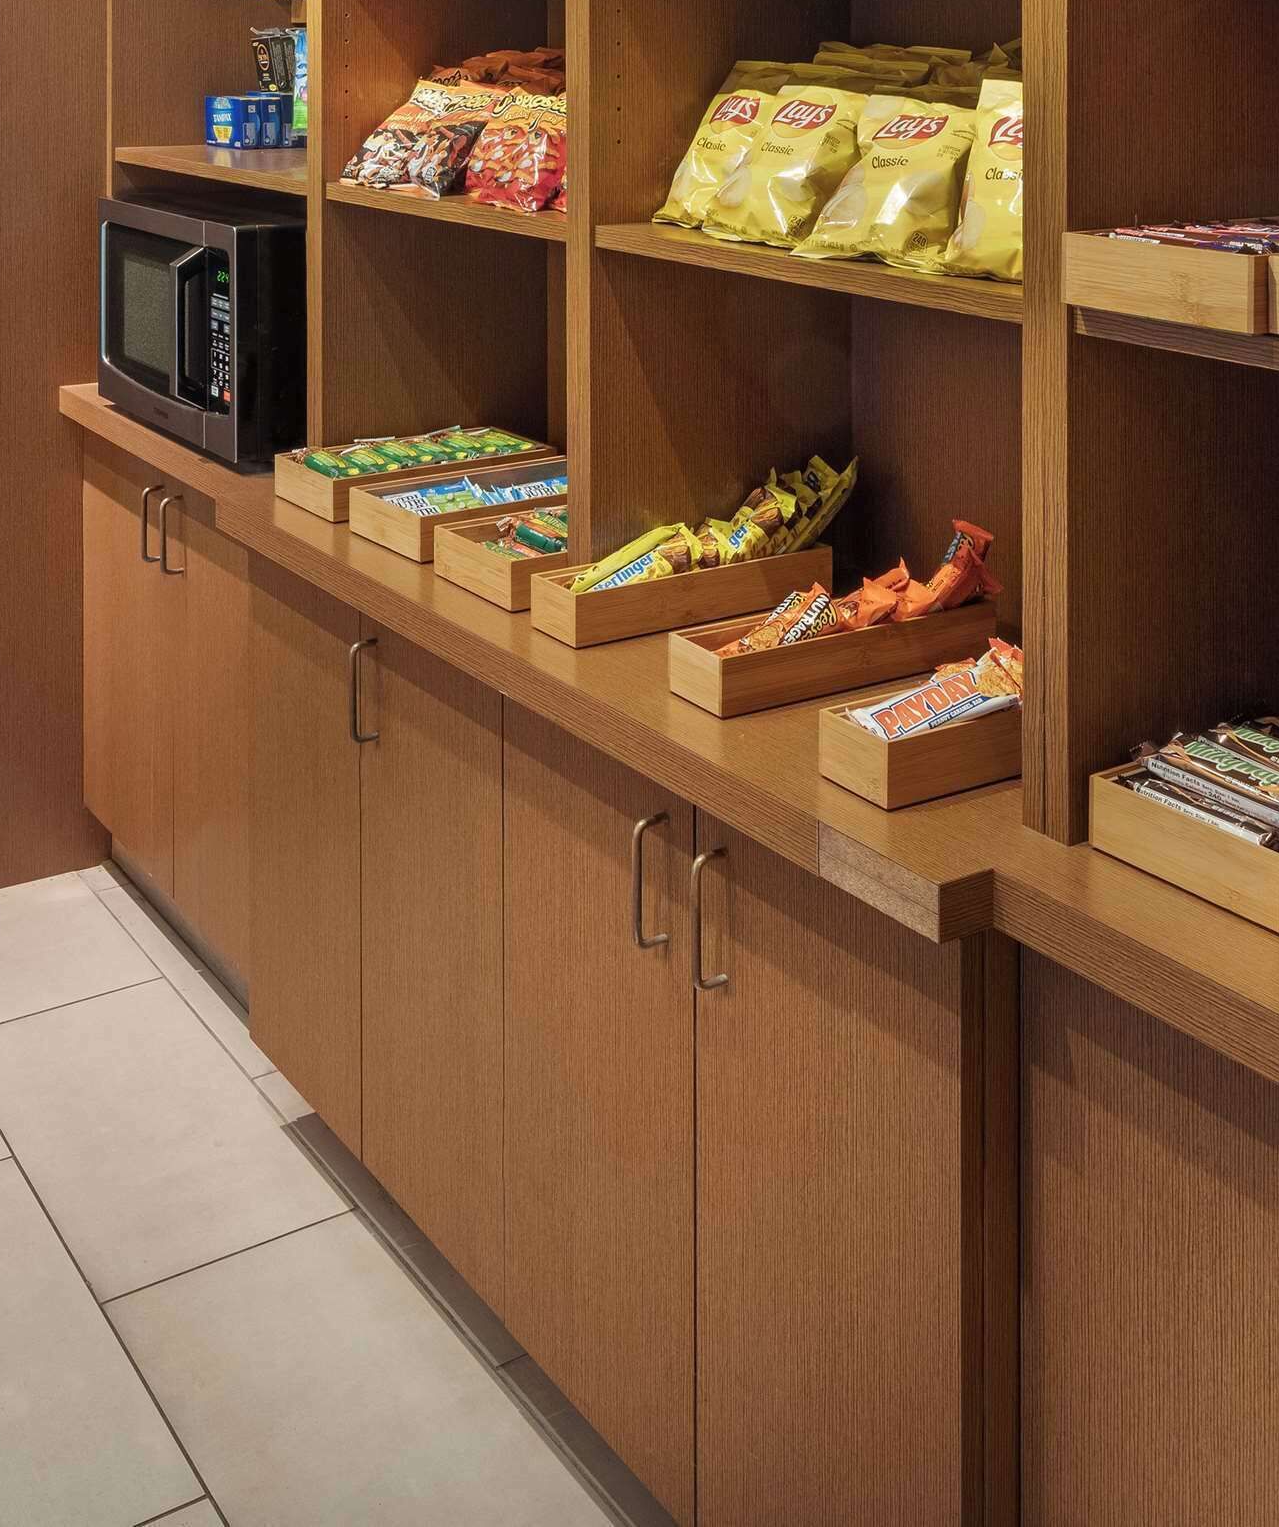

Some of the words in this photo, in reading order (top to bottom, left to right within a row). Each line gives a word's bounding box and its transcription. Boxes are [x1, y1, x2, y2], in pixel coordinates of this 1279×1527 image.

[776, 99, 837, 131] Lay's
[877, 113, 950, 141] Lay's
[696, 136, 727, 153] Classic
[760, 141, 795, 156] Classic
[871, 155, 910, 170] Classic
[874, 670, 979, 739] PAYDAY
[930, 713, 952, 729] PEANUT
